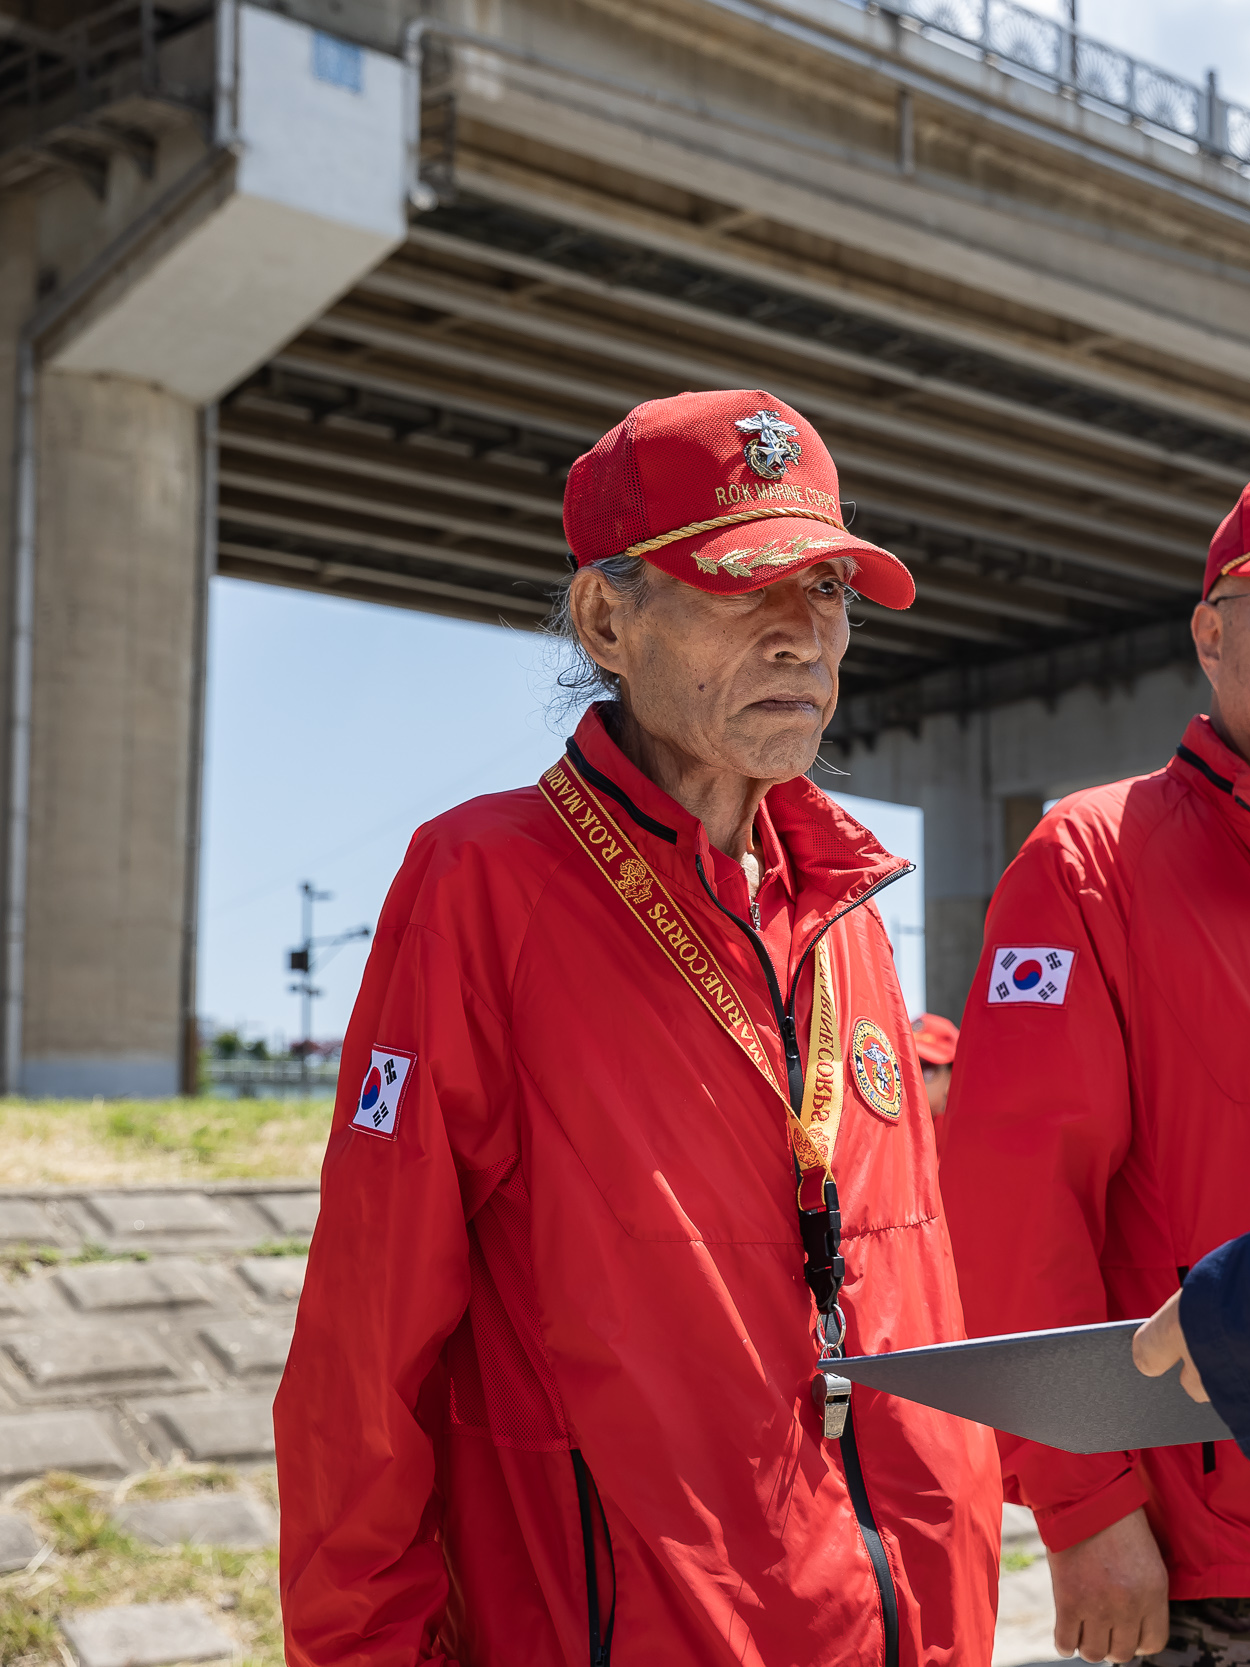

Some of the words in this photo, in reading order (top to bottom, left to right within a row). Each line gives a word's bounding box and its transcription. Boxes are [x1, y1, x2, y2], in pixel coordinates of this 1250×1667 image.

[754, 483, 805, 503] MARINE
[805, 487, 837, 513] CORPS
[575, 806, 623, 863] R.O.K
